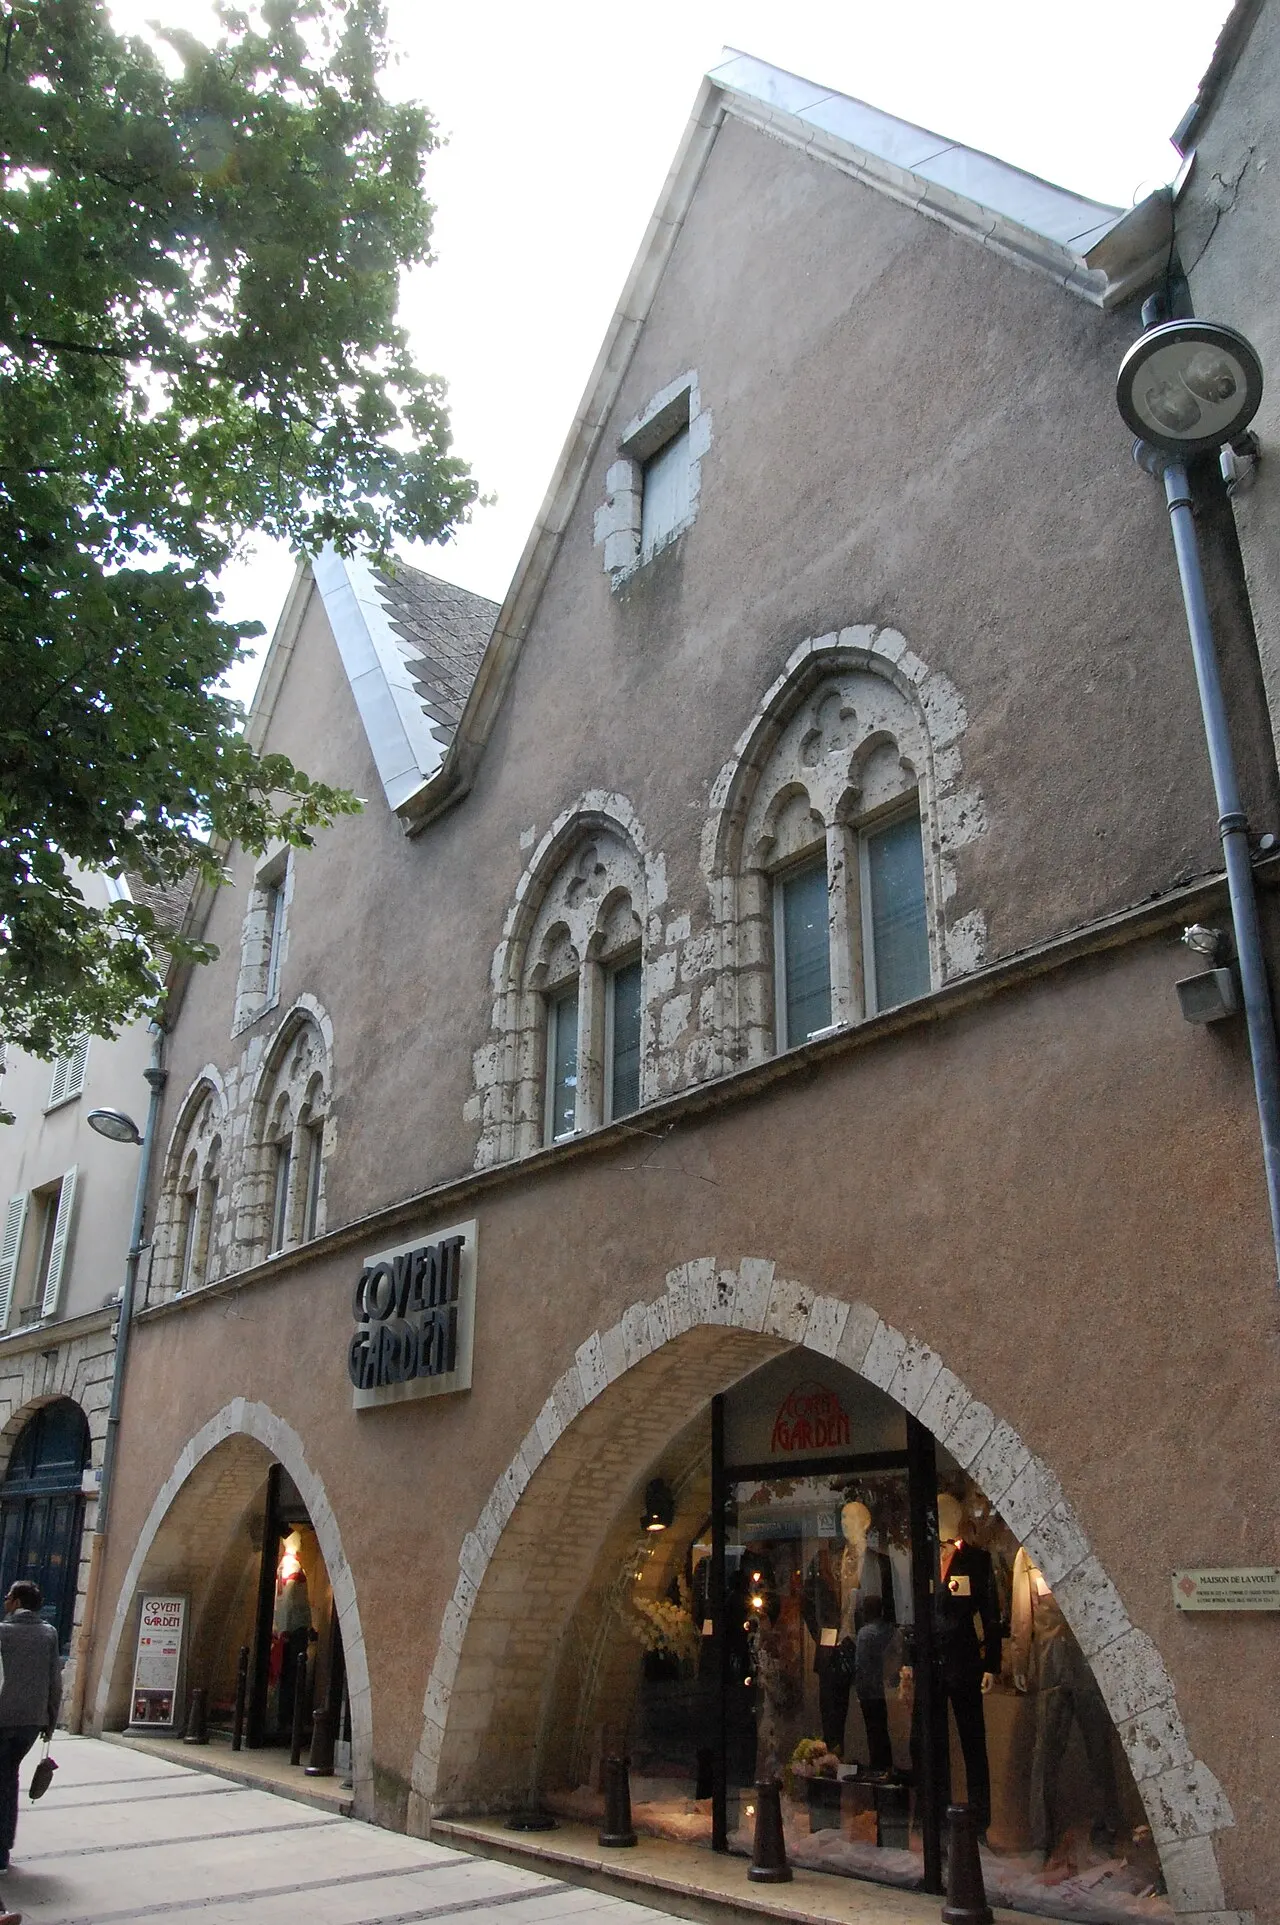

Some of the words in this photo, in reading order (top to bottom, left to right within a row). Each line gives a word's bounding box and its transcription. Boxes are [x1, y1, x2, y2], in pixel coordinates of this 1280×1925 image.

[352, 1235, 466, 1323] COVENT
[348, 1307, 458, 1389] GARDEN
[776, 1414, 851, 1450] GARDEN
[1200, 1576, 1230, 1584] MAISON
[1230, 1576, 1240, 1584] DE
[145, 1602, 181, 1614] COVENT
[144, 1616, 180, 1627] GARDEN
